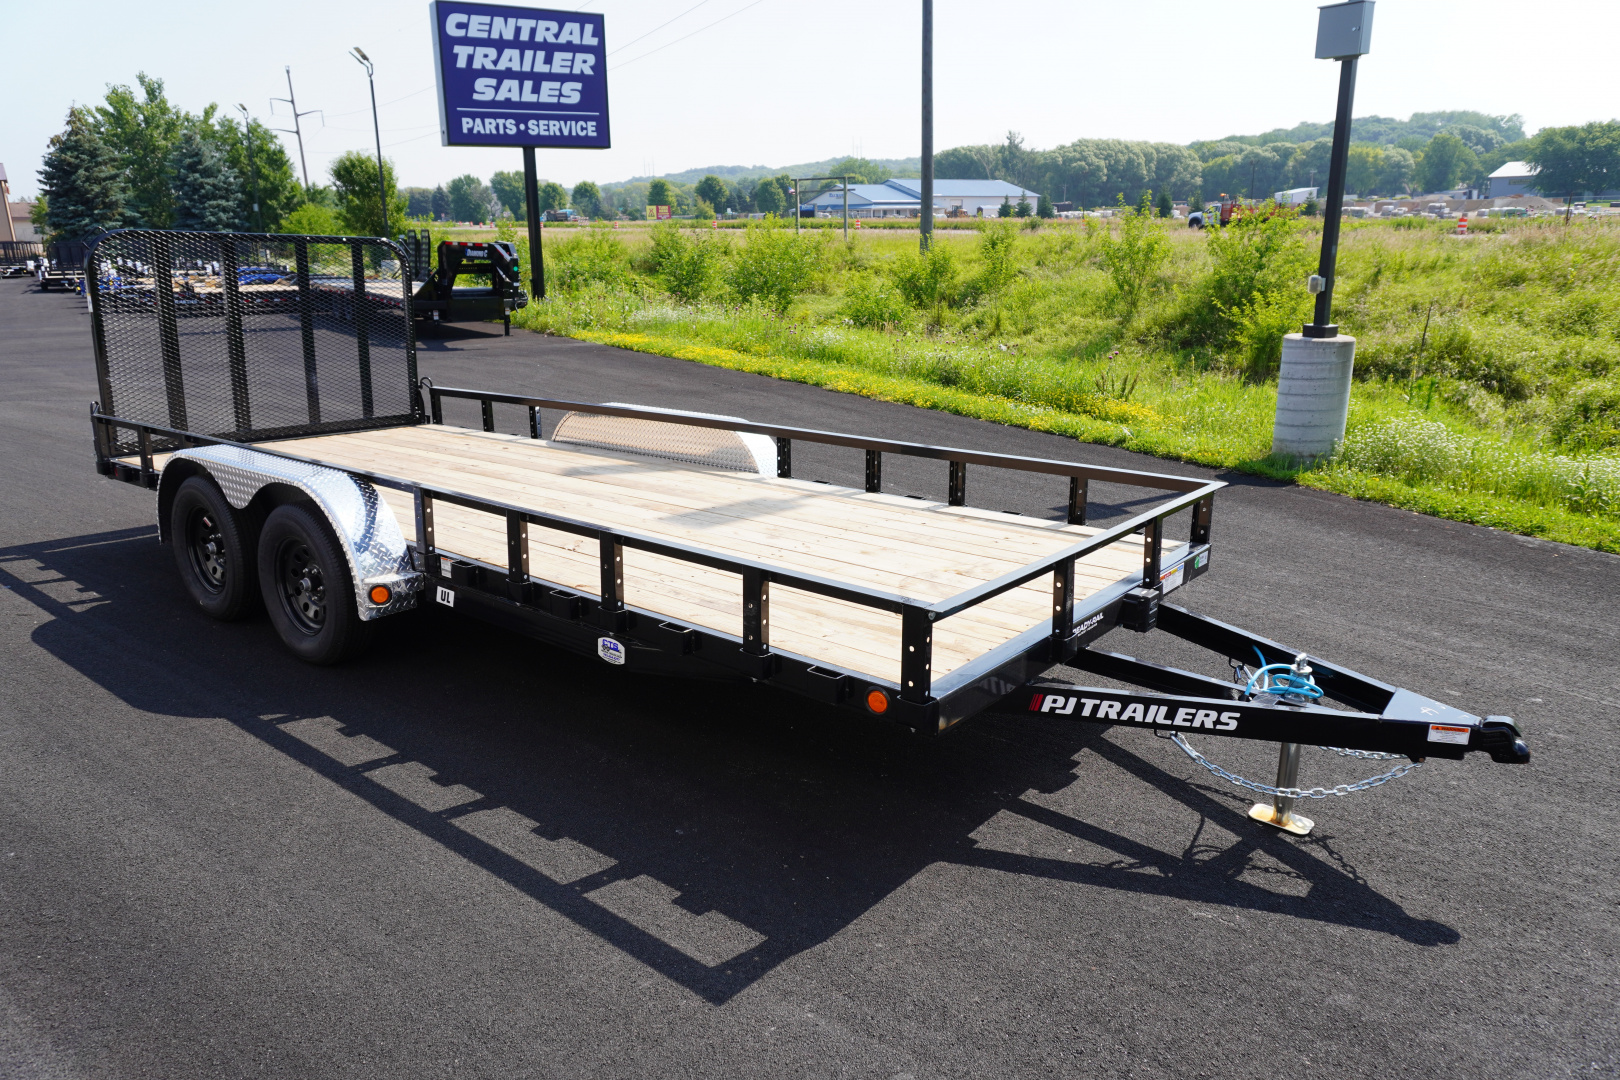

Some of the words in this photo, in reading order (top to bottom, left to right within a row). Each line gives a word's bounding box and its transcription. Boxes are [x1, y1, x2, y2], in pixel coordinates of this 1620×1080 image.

[445, 13, 599, 46] CENTRAL
[452, 45, 596, 75] TRAILER
[472, 77, 583, 104] SALES
[461, 117, 517, 135] PARTS
[527, 119, 597, 137] SERVICE
[440, 590, 451, 604] UL
[1040, 695, 1077, 715] PJ
[1080, 698, 1241, 731] TRAILERS
